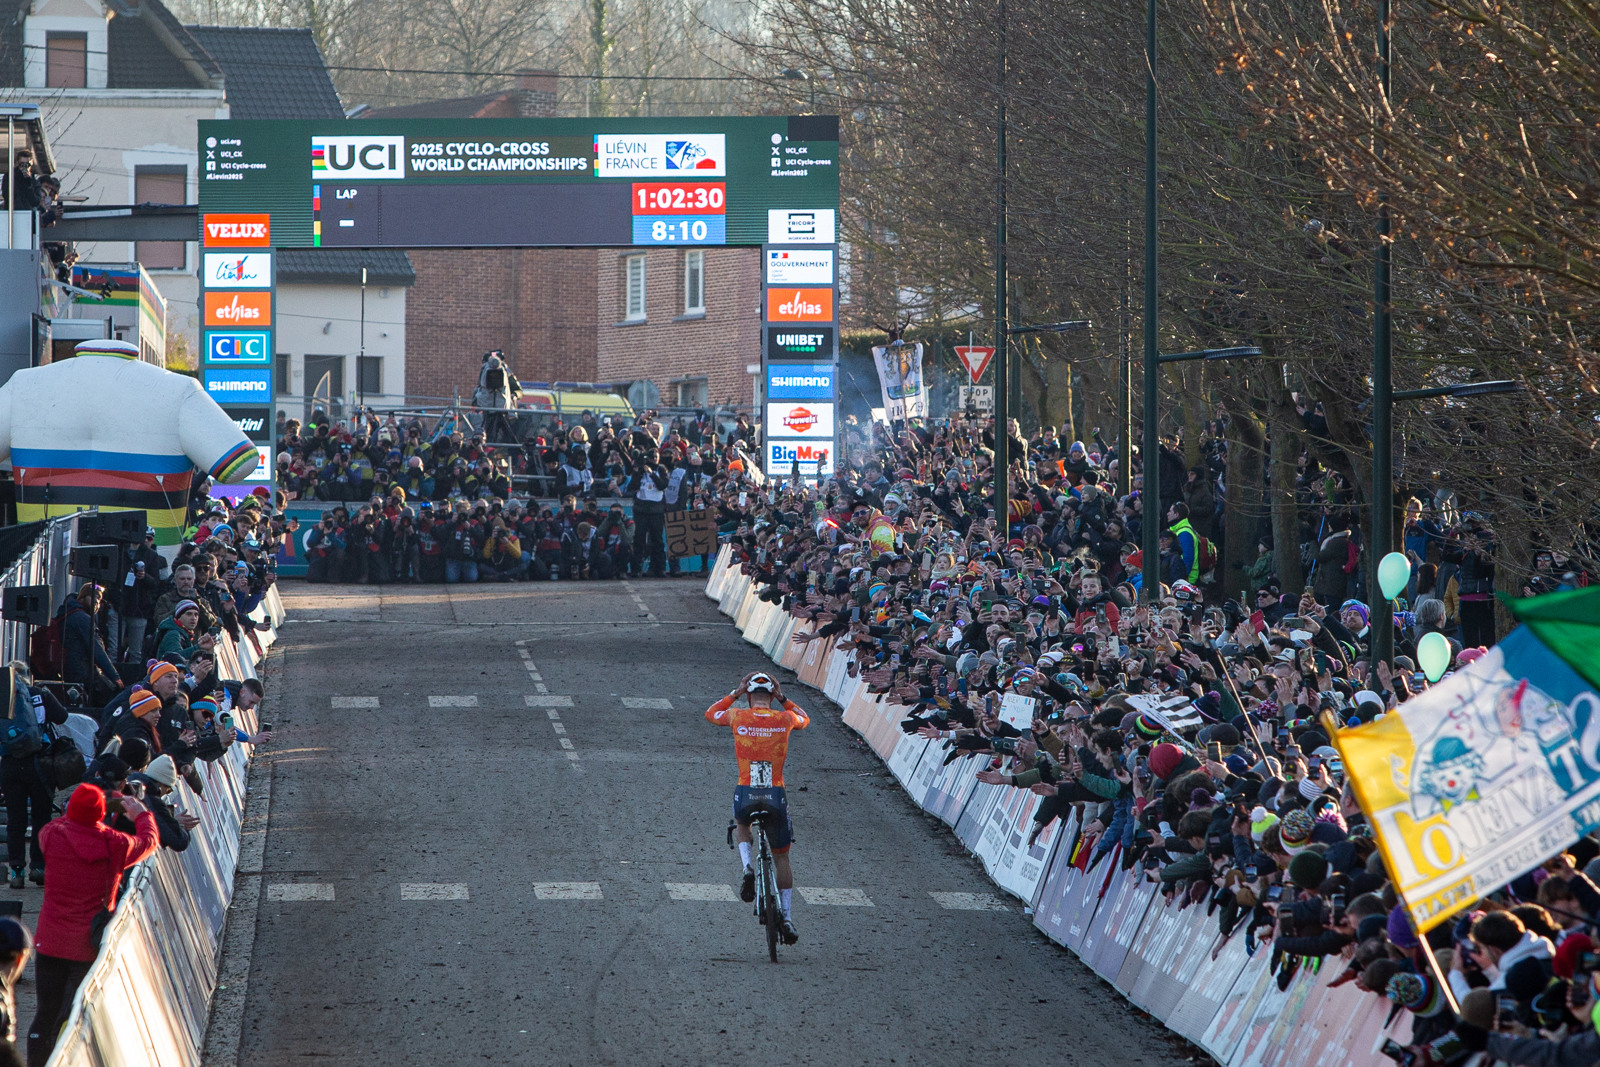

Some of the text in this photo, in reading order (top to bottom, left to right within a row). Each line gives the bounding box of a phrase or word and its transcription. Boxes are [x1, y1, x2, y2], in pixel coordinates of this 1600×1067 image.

[220, 138, 242, 146] uci.org
[411, 142, 550, 156] 2025 CYCLO-CROSS
[605, 140, 647, 154] LIÉVIN
[328, 144, 397, 171] UCI
[785, 147, 808, 155] UCI_CX
[232, 162, 267, 170] Cyclo-cross
[411, 157, 588, 171] WORLD CHAMPIONSHIPS
[605, 157, 658, 170] FRANCE
[336, 189, 357, 199] LAP
[637, 188, 724, 209] 1:02:30
[207, 223, 265, 238] VELUX
[651, 221, 708, 240] 8:10
[215, 294, 260, 322] ethias
[778, 291, 822, 318] ethias
[215, 338, 260, 356] CIC
[776, 334, 824, 346] UNIBET
[208, 381, 267, 391] SHIMANO
[771, 377, 829, 387] SHIMANO
[232, 418, 264, 431] ntini
[771, 445, 829, 462] BigMat
